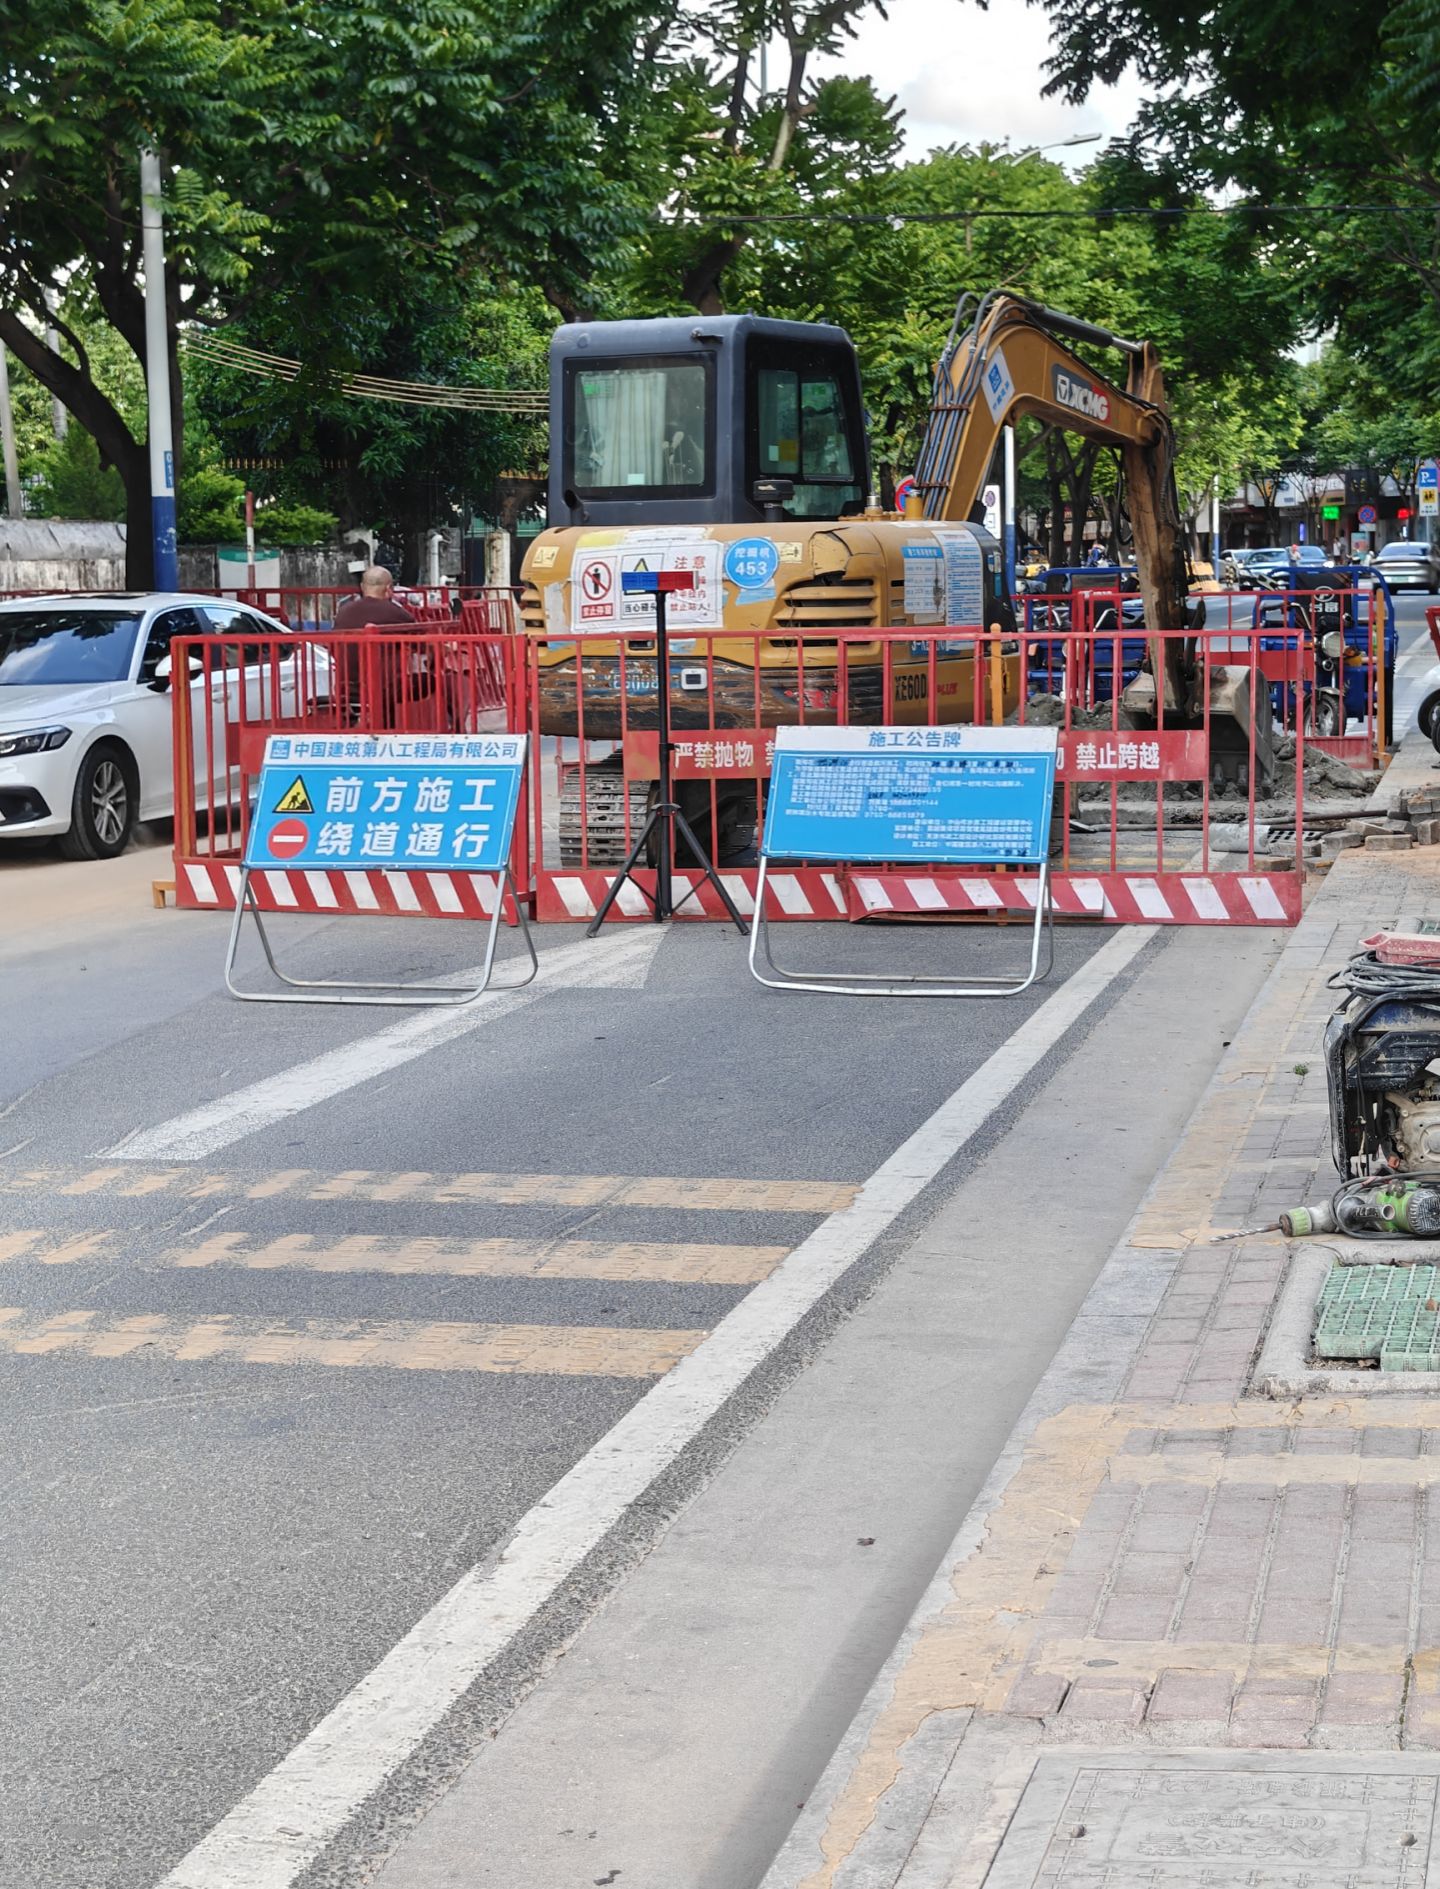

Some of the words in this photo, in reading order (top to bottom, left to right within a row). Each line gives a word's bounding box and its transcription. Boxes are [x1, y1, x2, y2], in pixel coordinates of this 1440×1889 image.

[1069, 383, 1109, 421] XCMG
[735, 561, 767, 576] 453
[294, 741, 519, 759] 中国建筑第八工程局有限公司
[868, 731, 962, 748] 施工公告牌
[674, 741, 754, 769] 严禁抛物
[1076, 742, 1160, 770] 禁止跨越
[325, 776, 497, 814] 前方施工
[315, 821, 491, 859] 绕道通行
